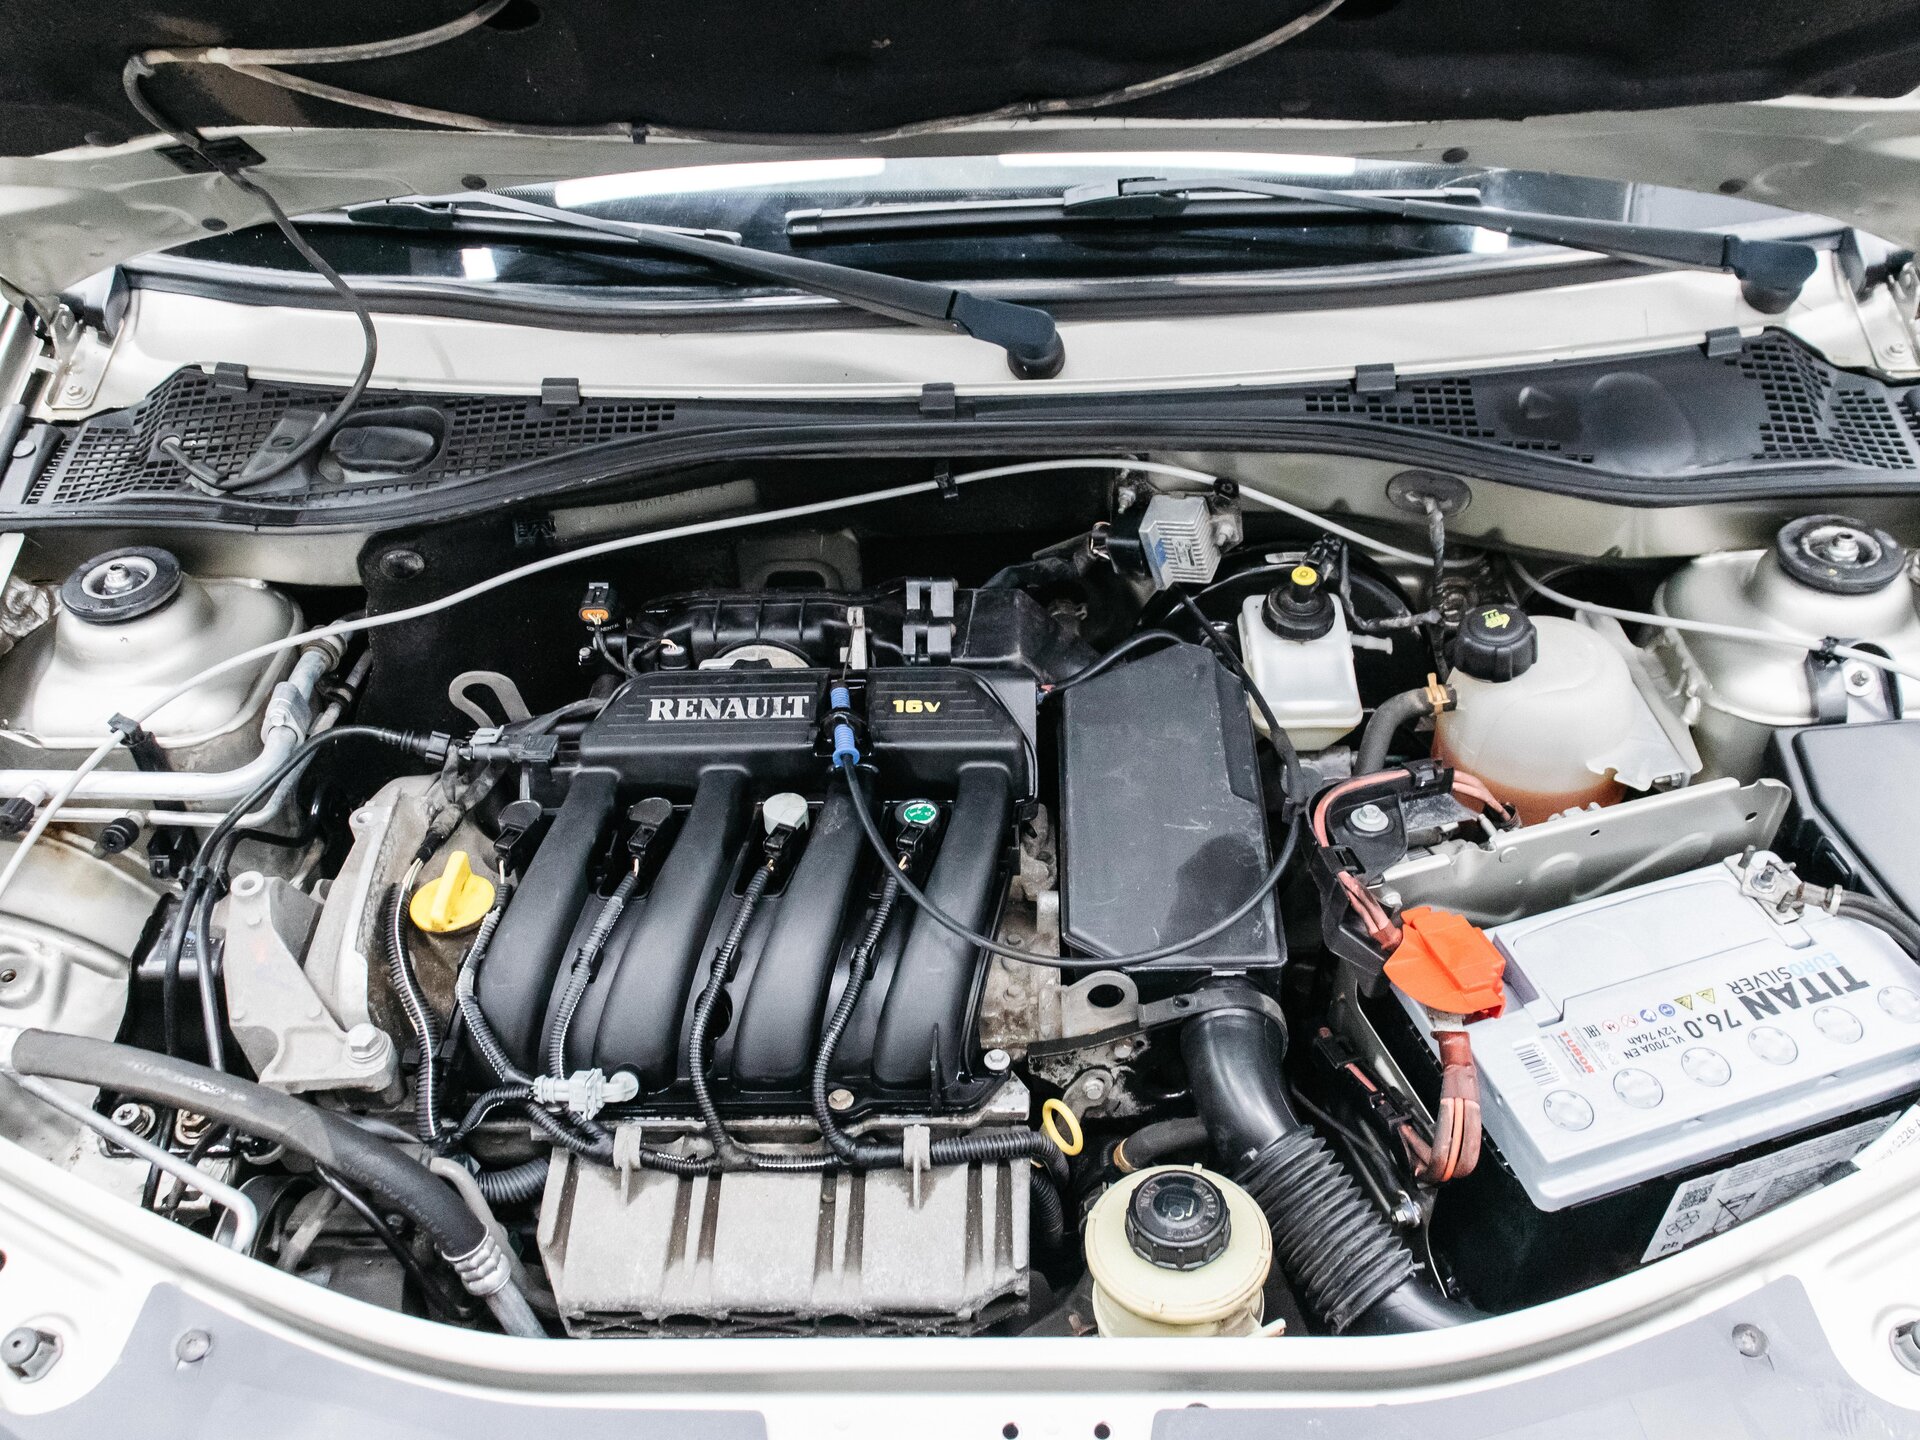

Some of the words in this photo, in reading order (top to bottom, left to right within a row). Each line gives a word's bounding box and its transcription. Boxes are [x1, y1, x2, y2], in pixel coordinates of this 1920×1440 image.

[648, 695, 809, 720] RENAULT
[1738, 965, 1871, 1020] TITAN
[1656, 1025, 1676, 1037] 12V
[1683, 1009, 1742, 1039] 76.0
[1627, 1031, 1655, 1045] 76Ah
[1642, 1040, 1669, 1054] 700A
[1558, 1030, 1595, 1074] TUBOR
[1623, 1049, 1641, 1060] EN
